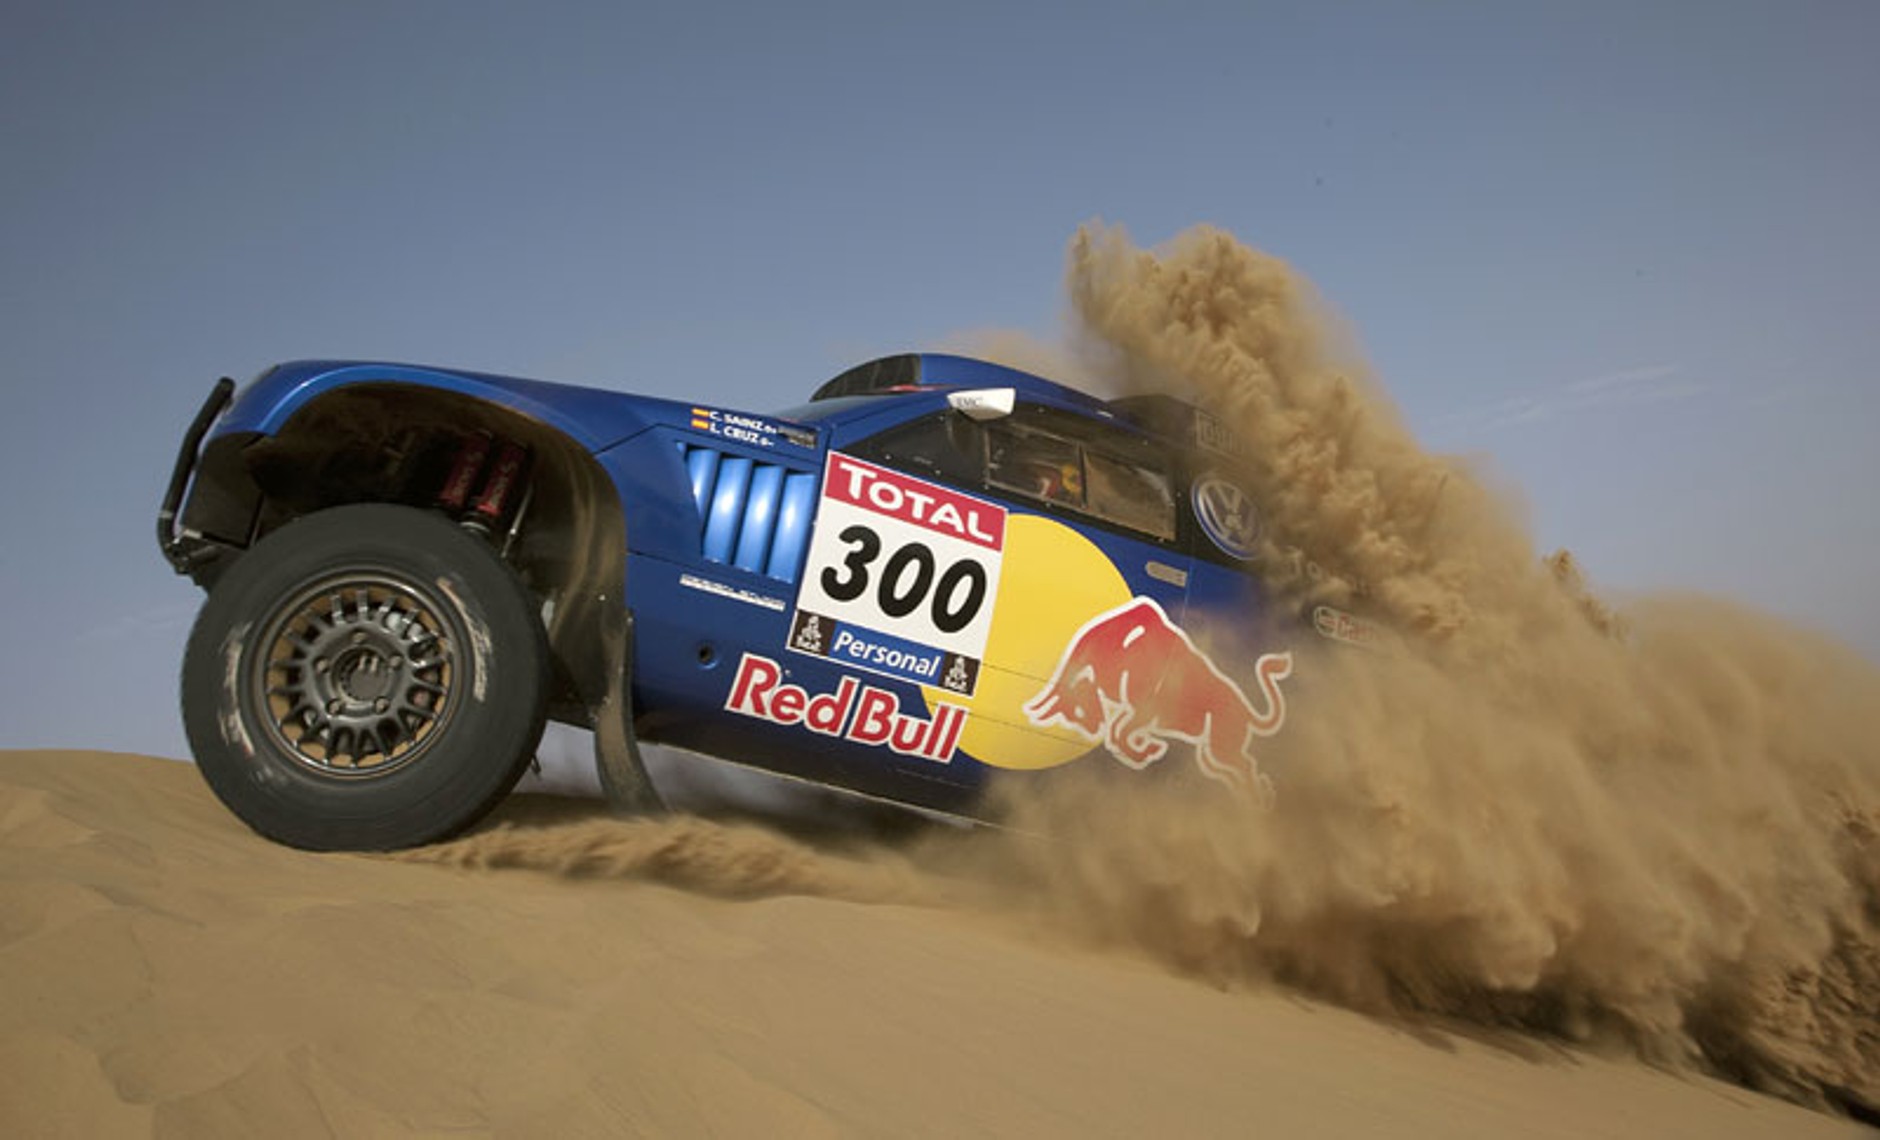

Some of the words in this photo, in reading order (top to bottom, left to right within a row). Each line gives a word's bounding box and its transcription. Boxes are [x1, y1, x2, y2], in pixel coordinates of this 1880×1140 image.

[723, 426, 759, 444] CRUZ
[839, 462, 995, 542] TOTAL
[820, 525, 988, 634] 300
[834, 631, 942, 677] Personal
[726, 654, 859, 736] Red
[847, 686, 968, 763] Bull
